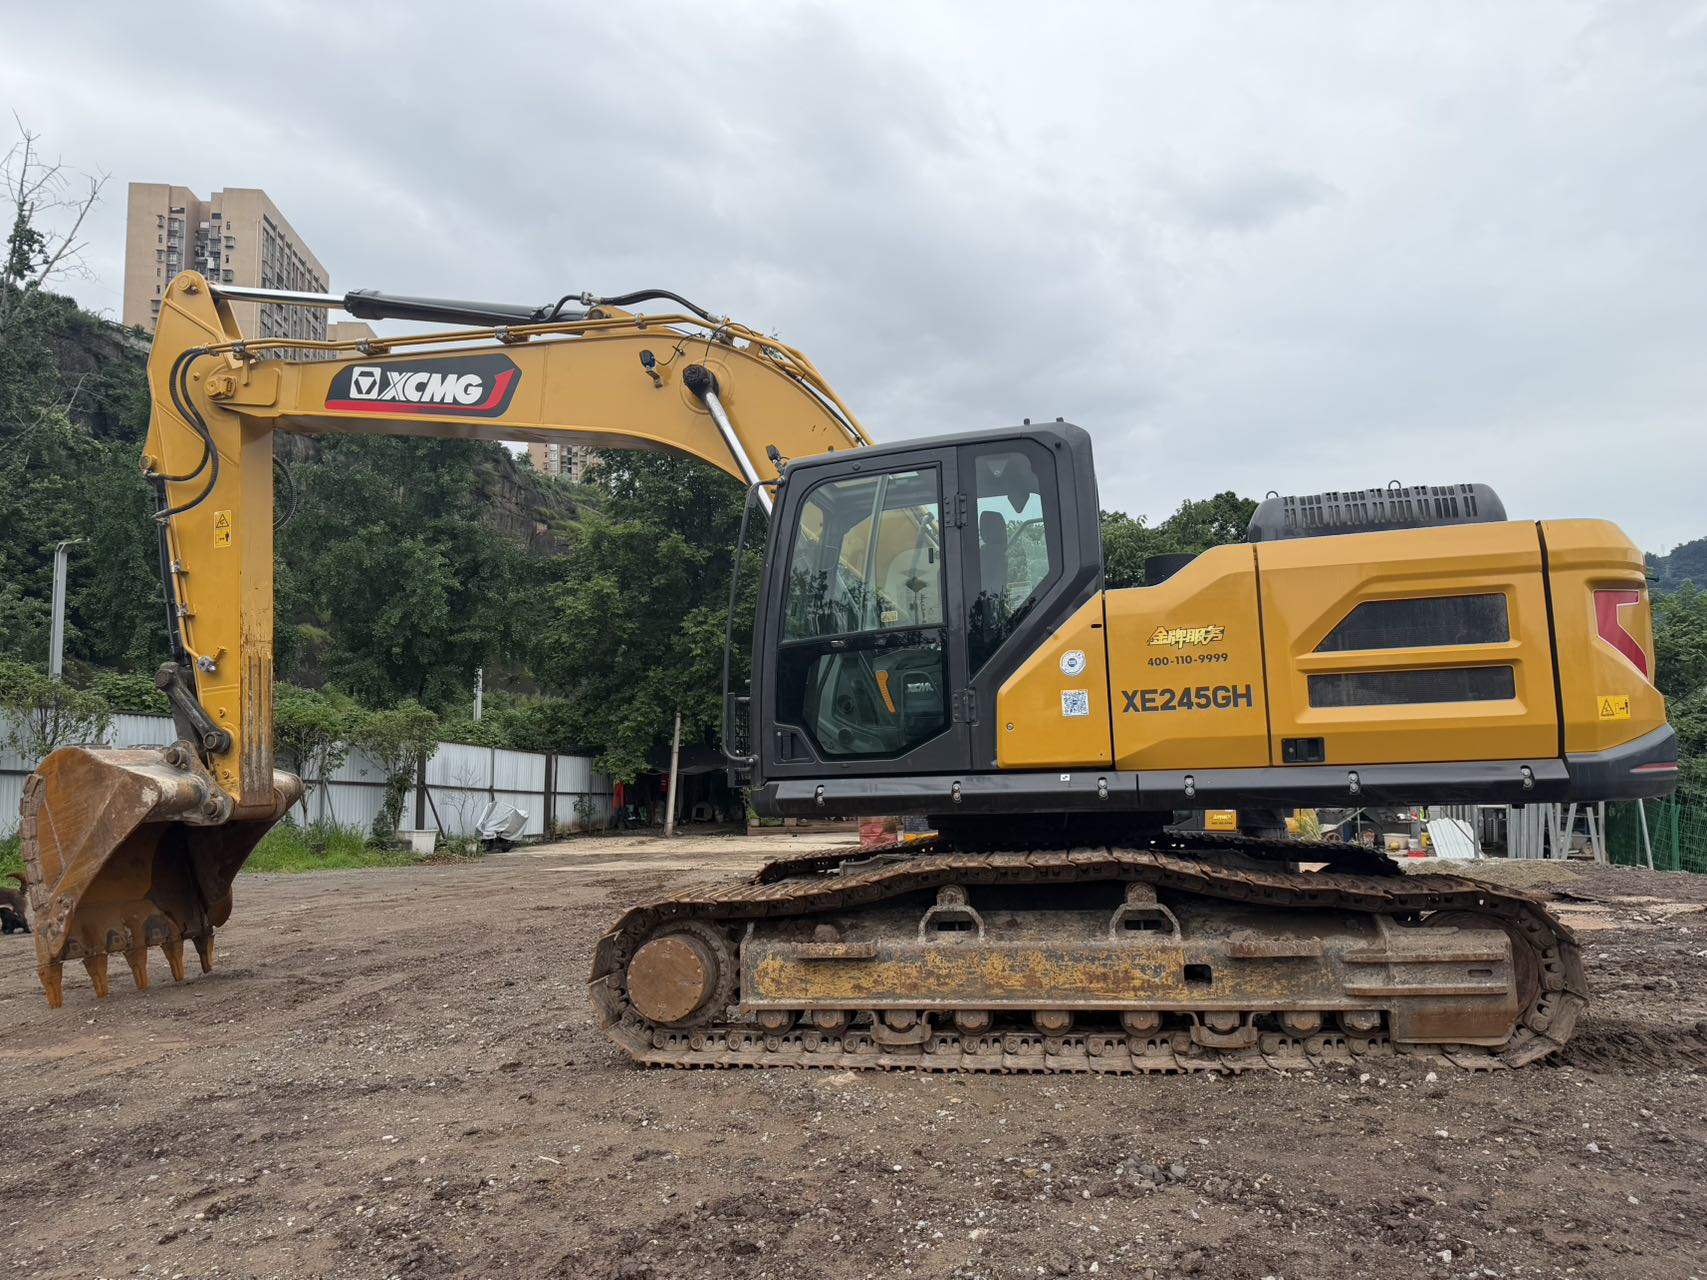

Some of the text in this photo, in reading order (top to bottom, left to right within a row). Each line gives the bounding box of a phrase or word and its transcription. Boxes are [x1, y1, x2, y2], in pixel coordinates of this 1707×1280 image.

[377, 371, 483, 404] XCMG
[1148, 624, 1226, 649] 金牌服务
[1147, 653, 1228, 666] 400-110-9999
[1121, 683, 1253, 713] XE245GH
